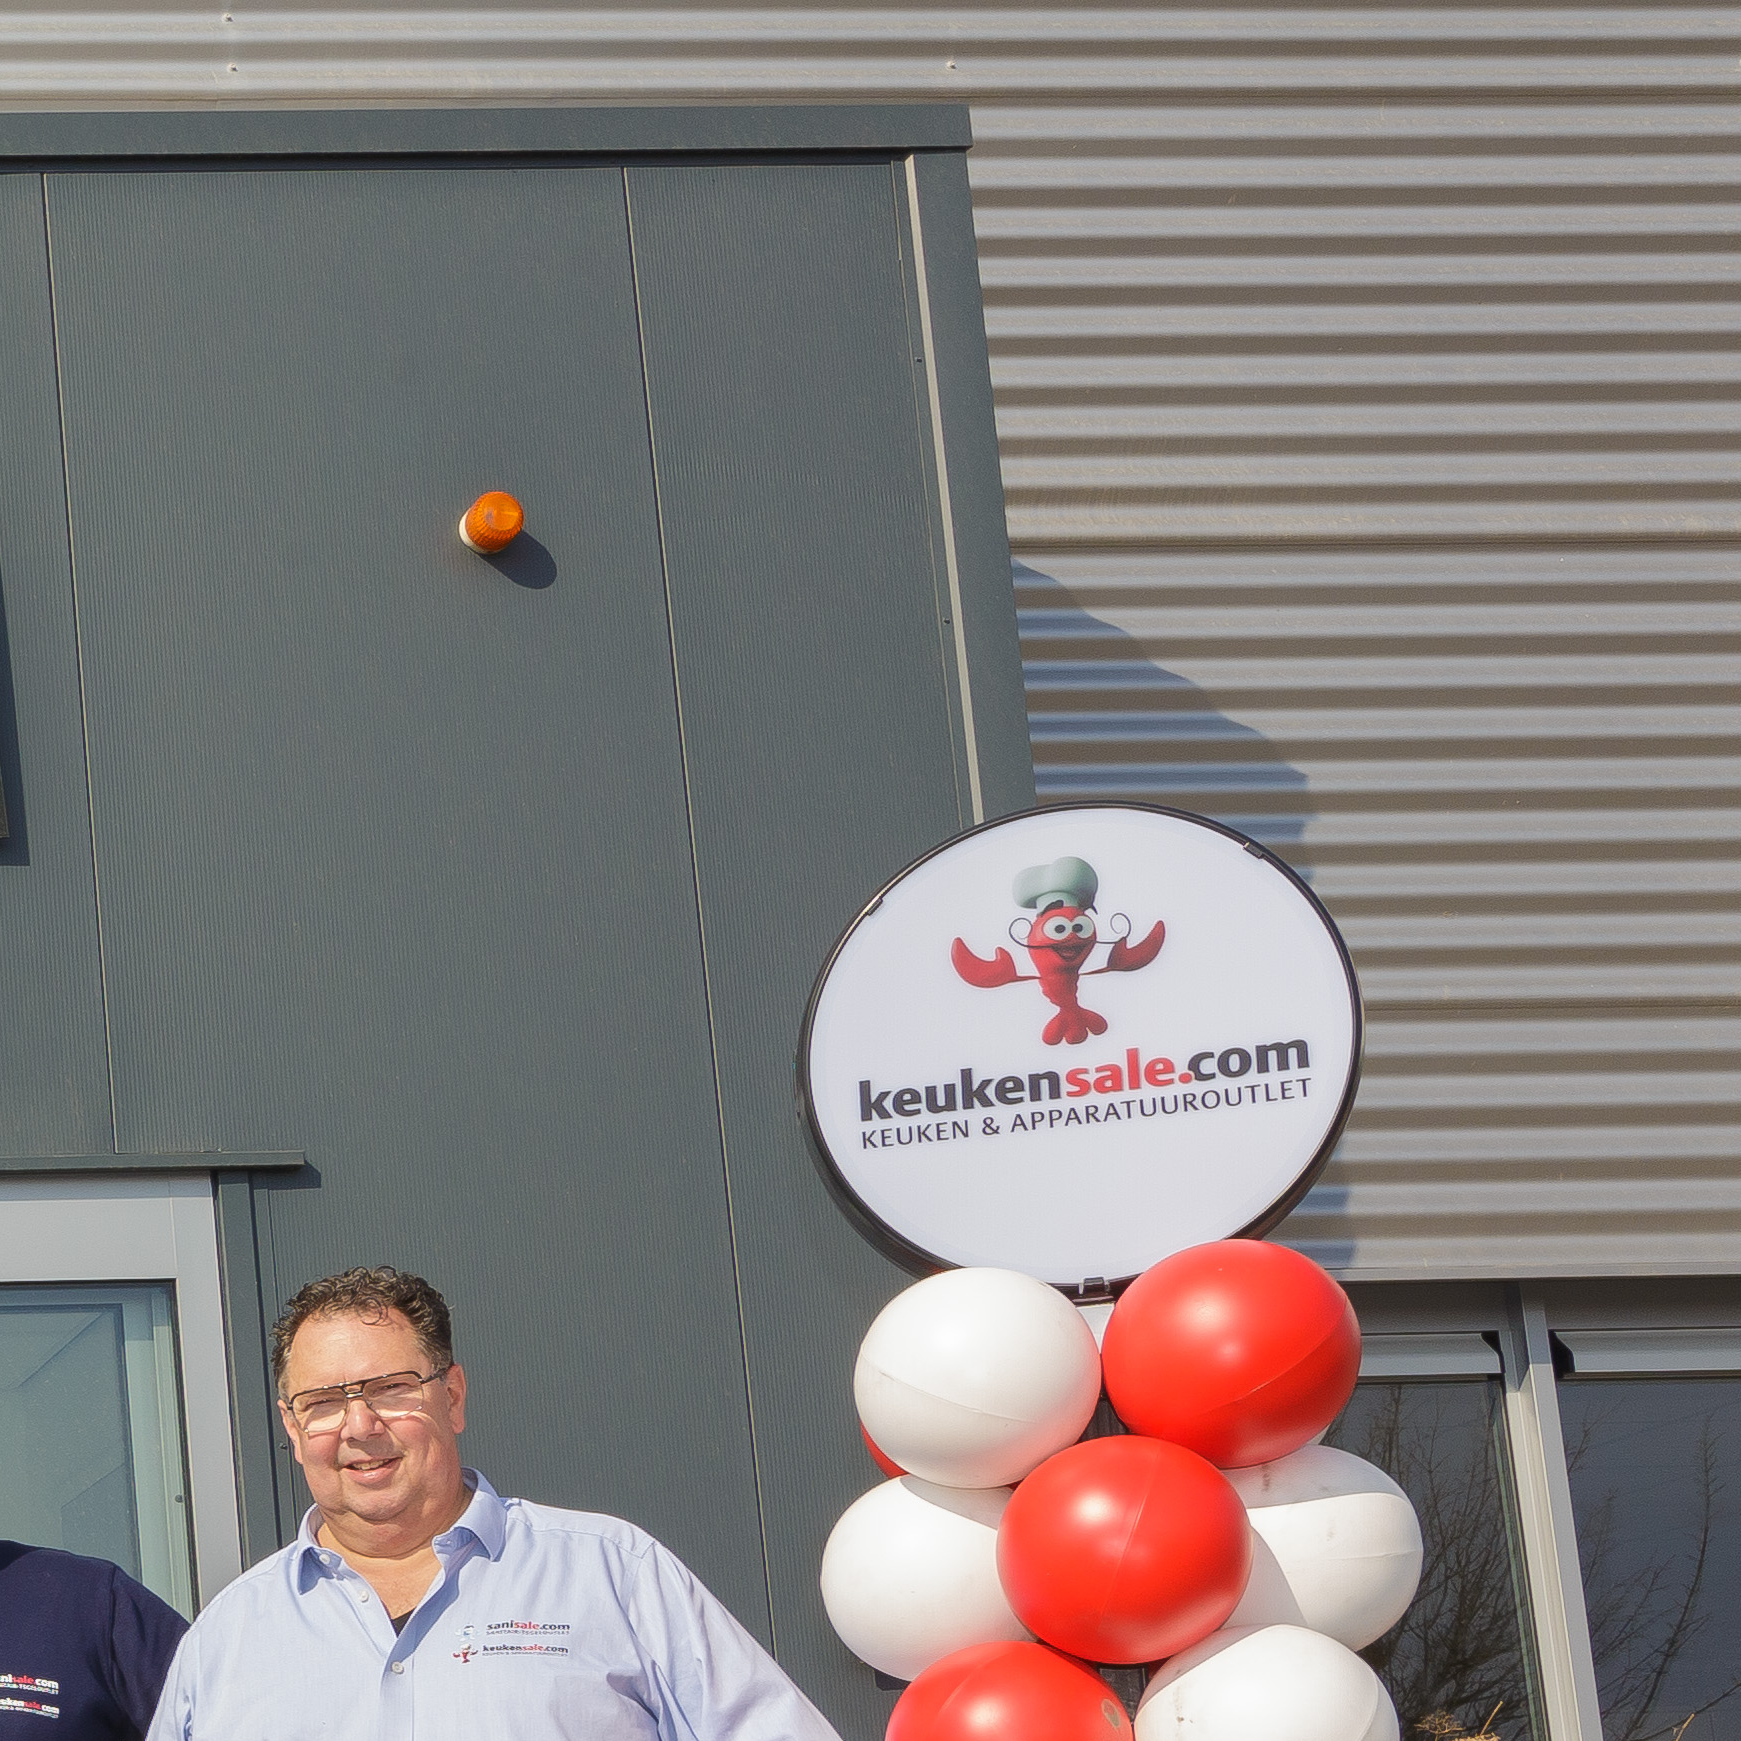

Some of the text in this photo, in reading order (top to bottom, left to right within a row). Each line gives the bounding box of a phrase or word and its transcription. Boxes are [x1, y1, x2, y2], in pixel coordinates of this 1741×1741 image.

[858, 1038, 1310, 1121] keukensale.com
[862, 1077, 1313, 1150] KEUKEN & APPARATUUROUTLET
